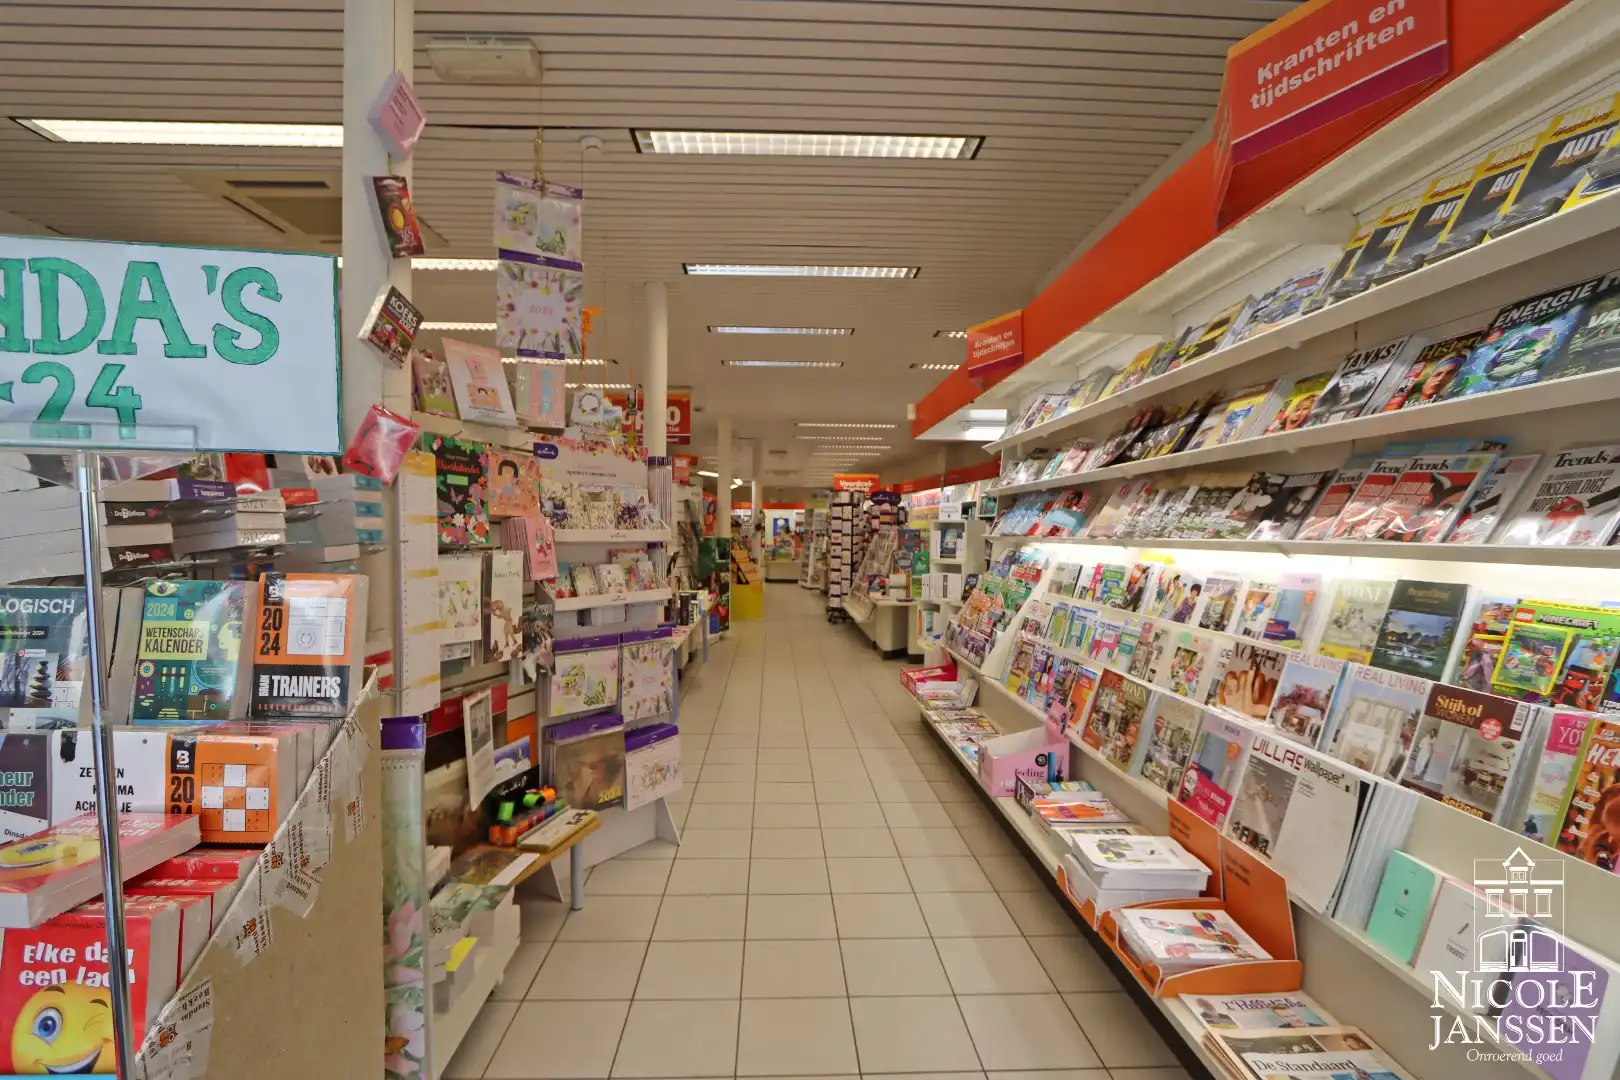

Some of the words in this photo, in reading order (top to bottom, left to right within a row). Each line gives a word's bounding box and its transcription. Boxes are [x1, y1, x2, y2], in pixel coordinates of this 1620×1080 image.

[1257, 20, 1358, 84] Kranten
[1369, 0, 1405, 24] en
[1250, 15, 1415, 109] tijdschriften
[390, 296, 417, 327] KOERS
[1494, 281, 1597, 328] ENERGIE
[975, 334, 1002, 348] Kranten
[1373, 461, 1407, 474] Tren
[1408, 458, 1450, 471] Trends
[1553, 451, 1609, 468] Trends
[147, 603, 174, 617] 2024
[262, 607, 283, 631] 20
[146, 627, 205, 639] WETENSCHAPS
[145, 638, 203, 655] KALENDER
[260, 632, 282, 656] 24
[272, 675, 341, 698] TRAINERS
[1355, 664, 1384, 685] REAL
[1388, 672, 1427, 695] LIVING
[1435, 694, 1484, 718] Stijlvol
[1014, 768, 1045, 779] feeling
[170, 776, 195, 803] 20
[121, 802, 132, 813] JE
[4, 828, 29, 840] Dinsd
[23, 942, 76, 965] Elke
[86, 941, 134, 966] da
[19, 966, 67, 987] een
[1252, 1059, 1275, 1071] De
[1276, 1060, 1358, 1073] Standaard
